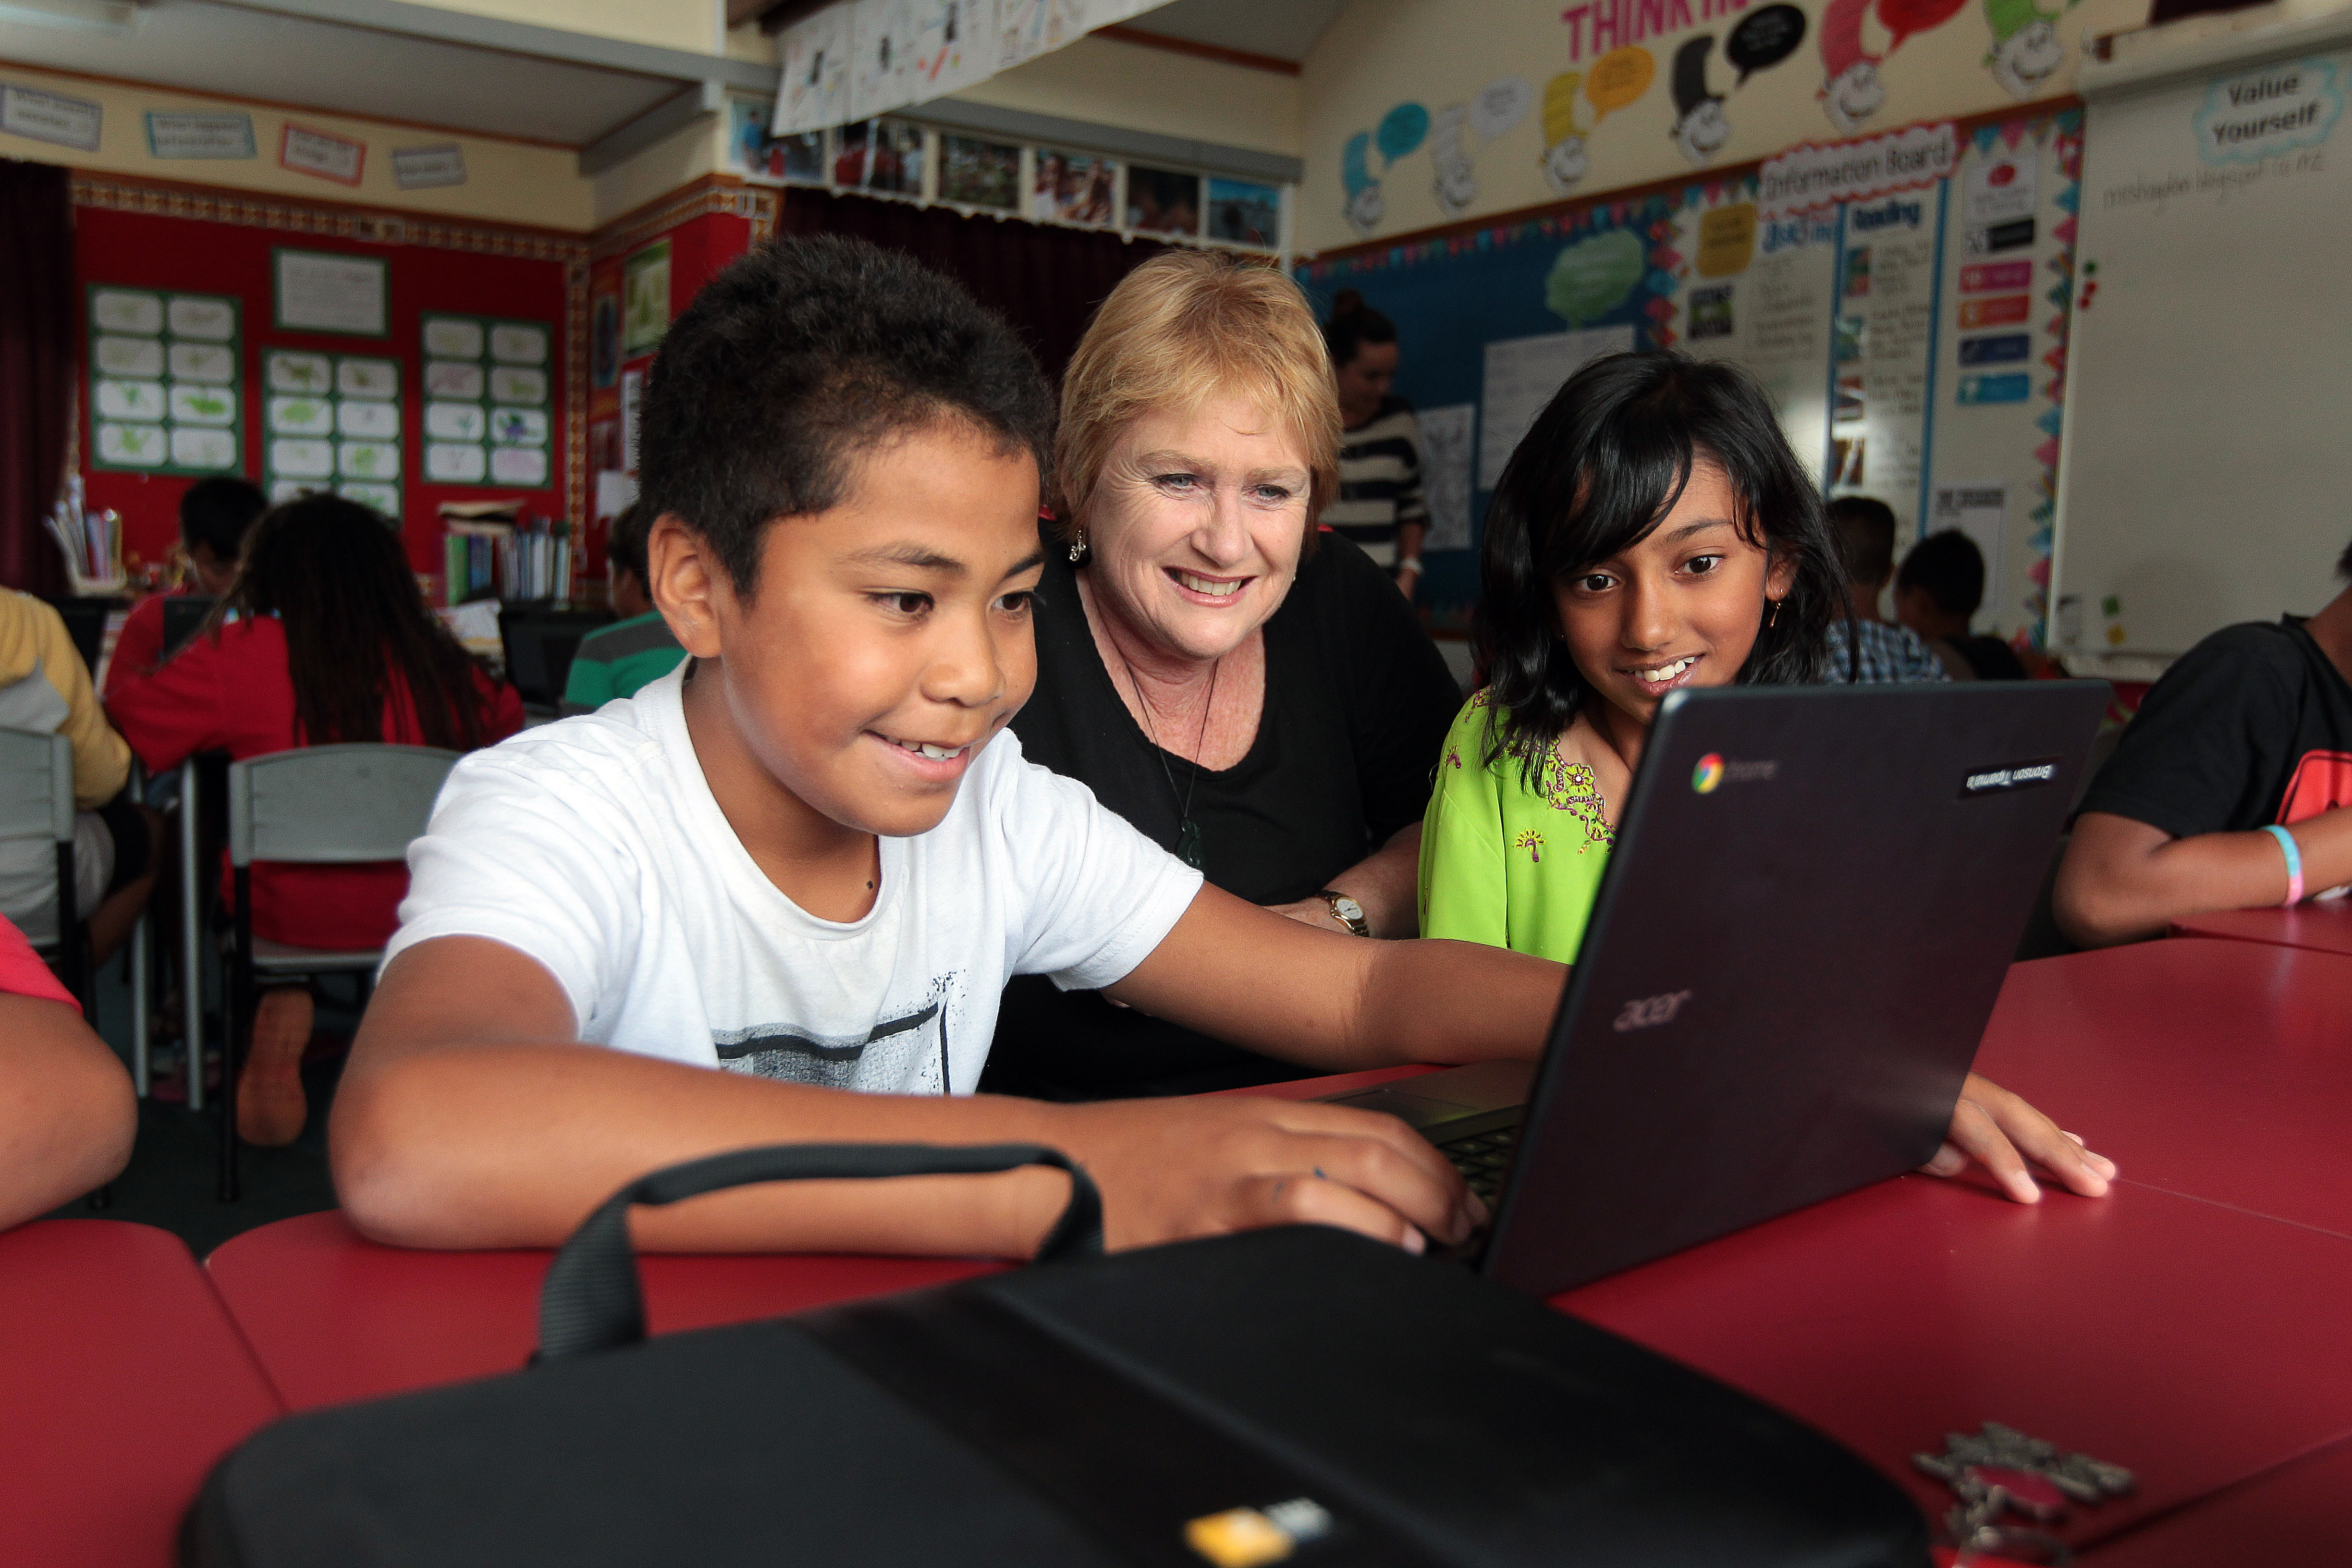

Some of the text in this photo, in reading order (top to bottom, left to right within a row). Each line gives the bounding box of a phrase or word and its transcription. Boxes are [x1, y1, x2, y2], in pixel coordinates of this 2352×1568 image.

[1561, 0, 1748, 62] THINK
[2230, 75, 2298, 104] Value
[2214, 102, 2318, 144] Yourself
[1767, 135, 1949, 198] Information Board
[2012, 764, 2054, 781] Bronson
[1613, 990, 1692, 1032] acer
